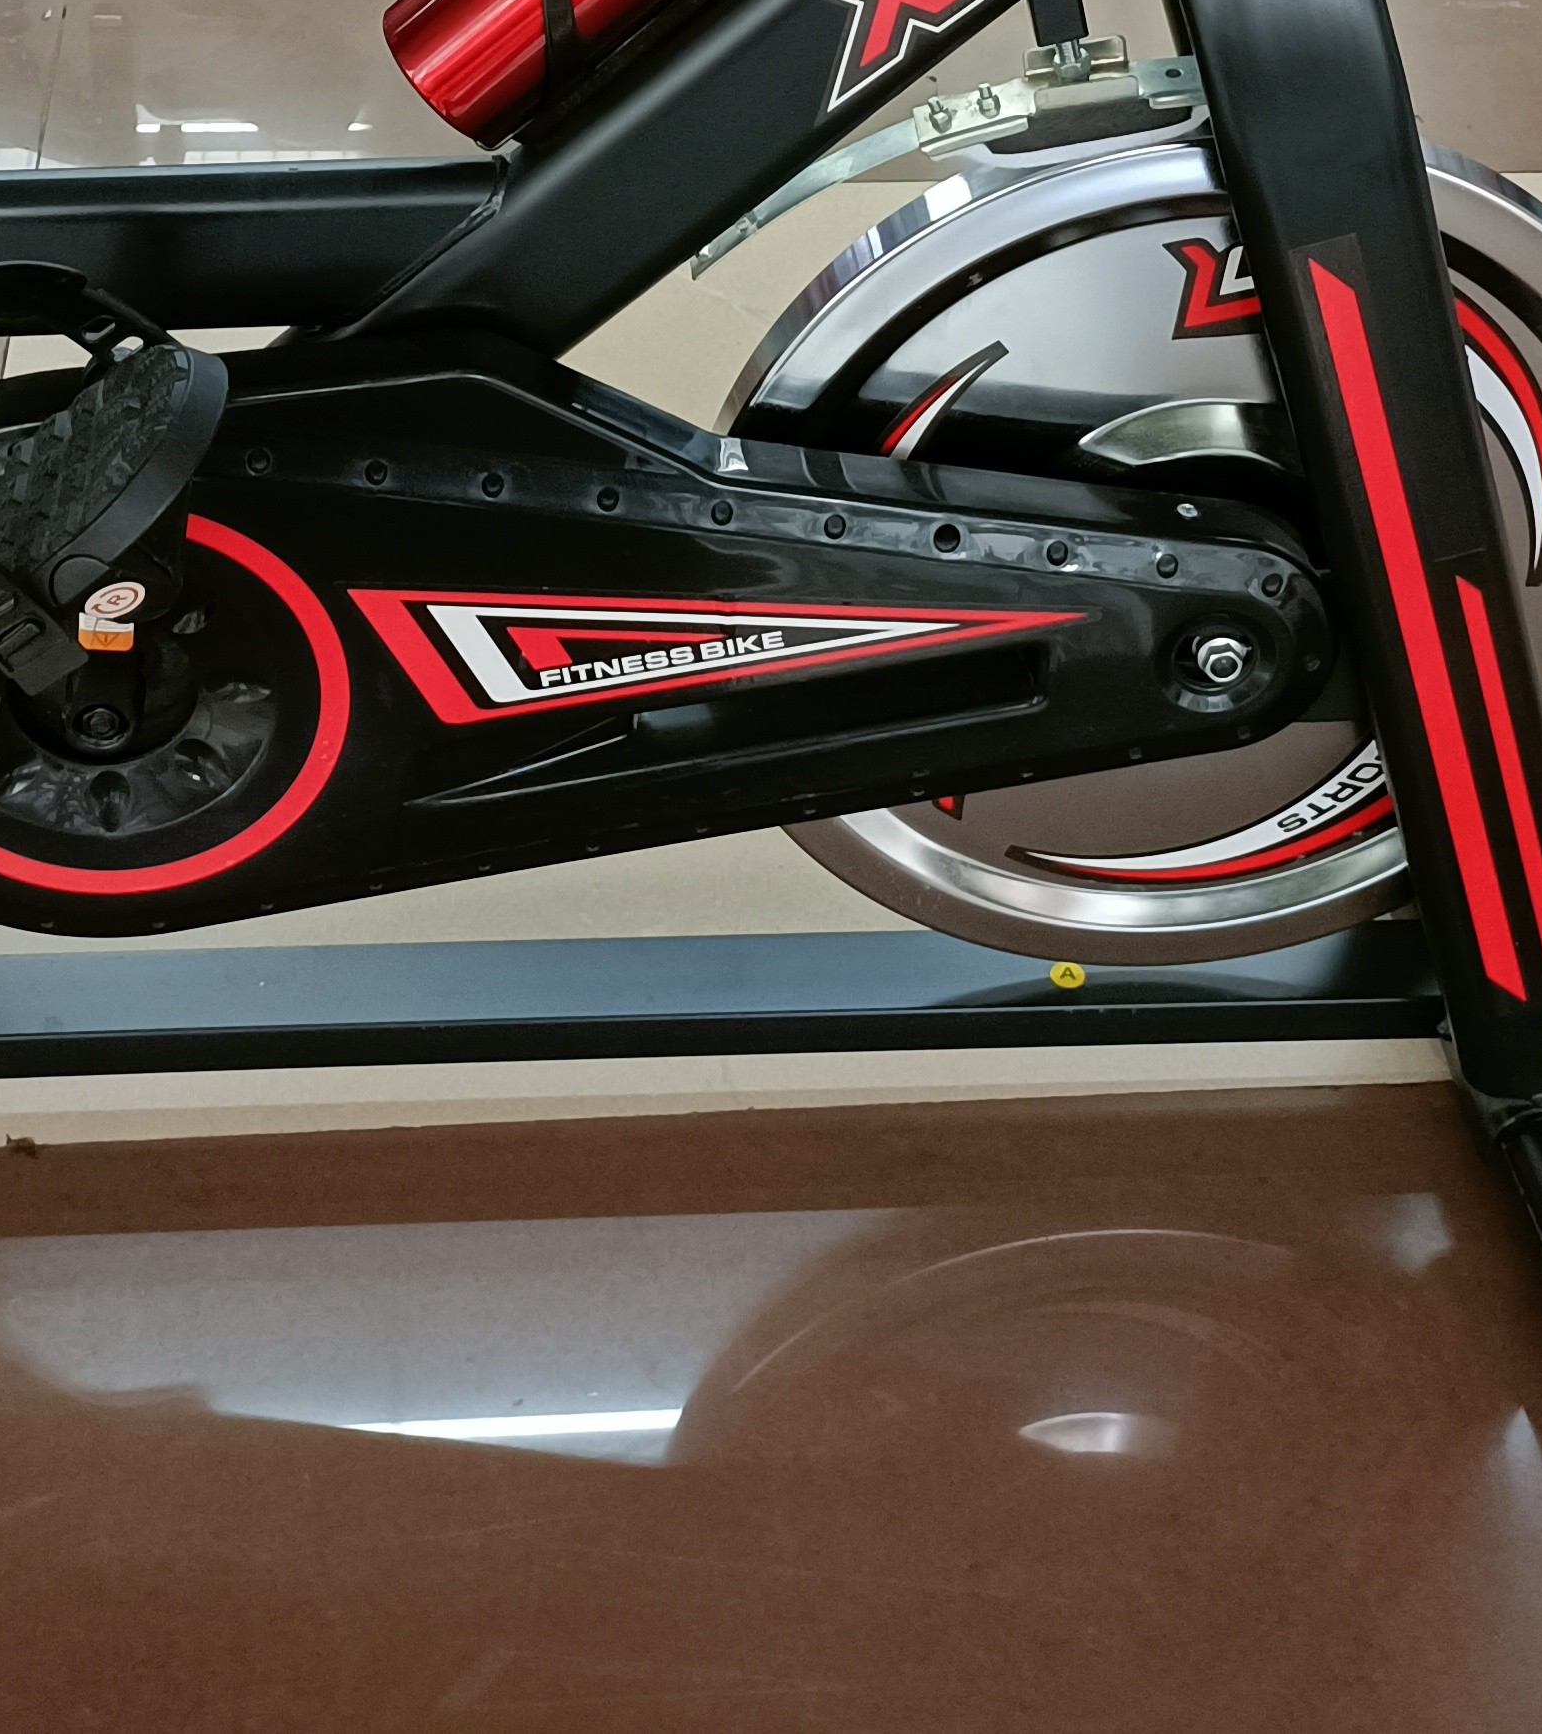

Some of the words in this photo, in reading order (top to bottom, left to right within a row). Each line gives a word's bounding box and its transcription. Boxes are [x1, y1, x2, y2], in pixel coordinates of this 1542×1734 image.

[540, 645, 695, 687] FITNESS
[699, 630, 785, 661] BIKE
[1276, 754, 1386, 833] ORTS
[1060, 966, 1076, 980] A
